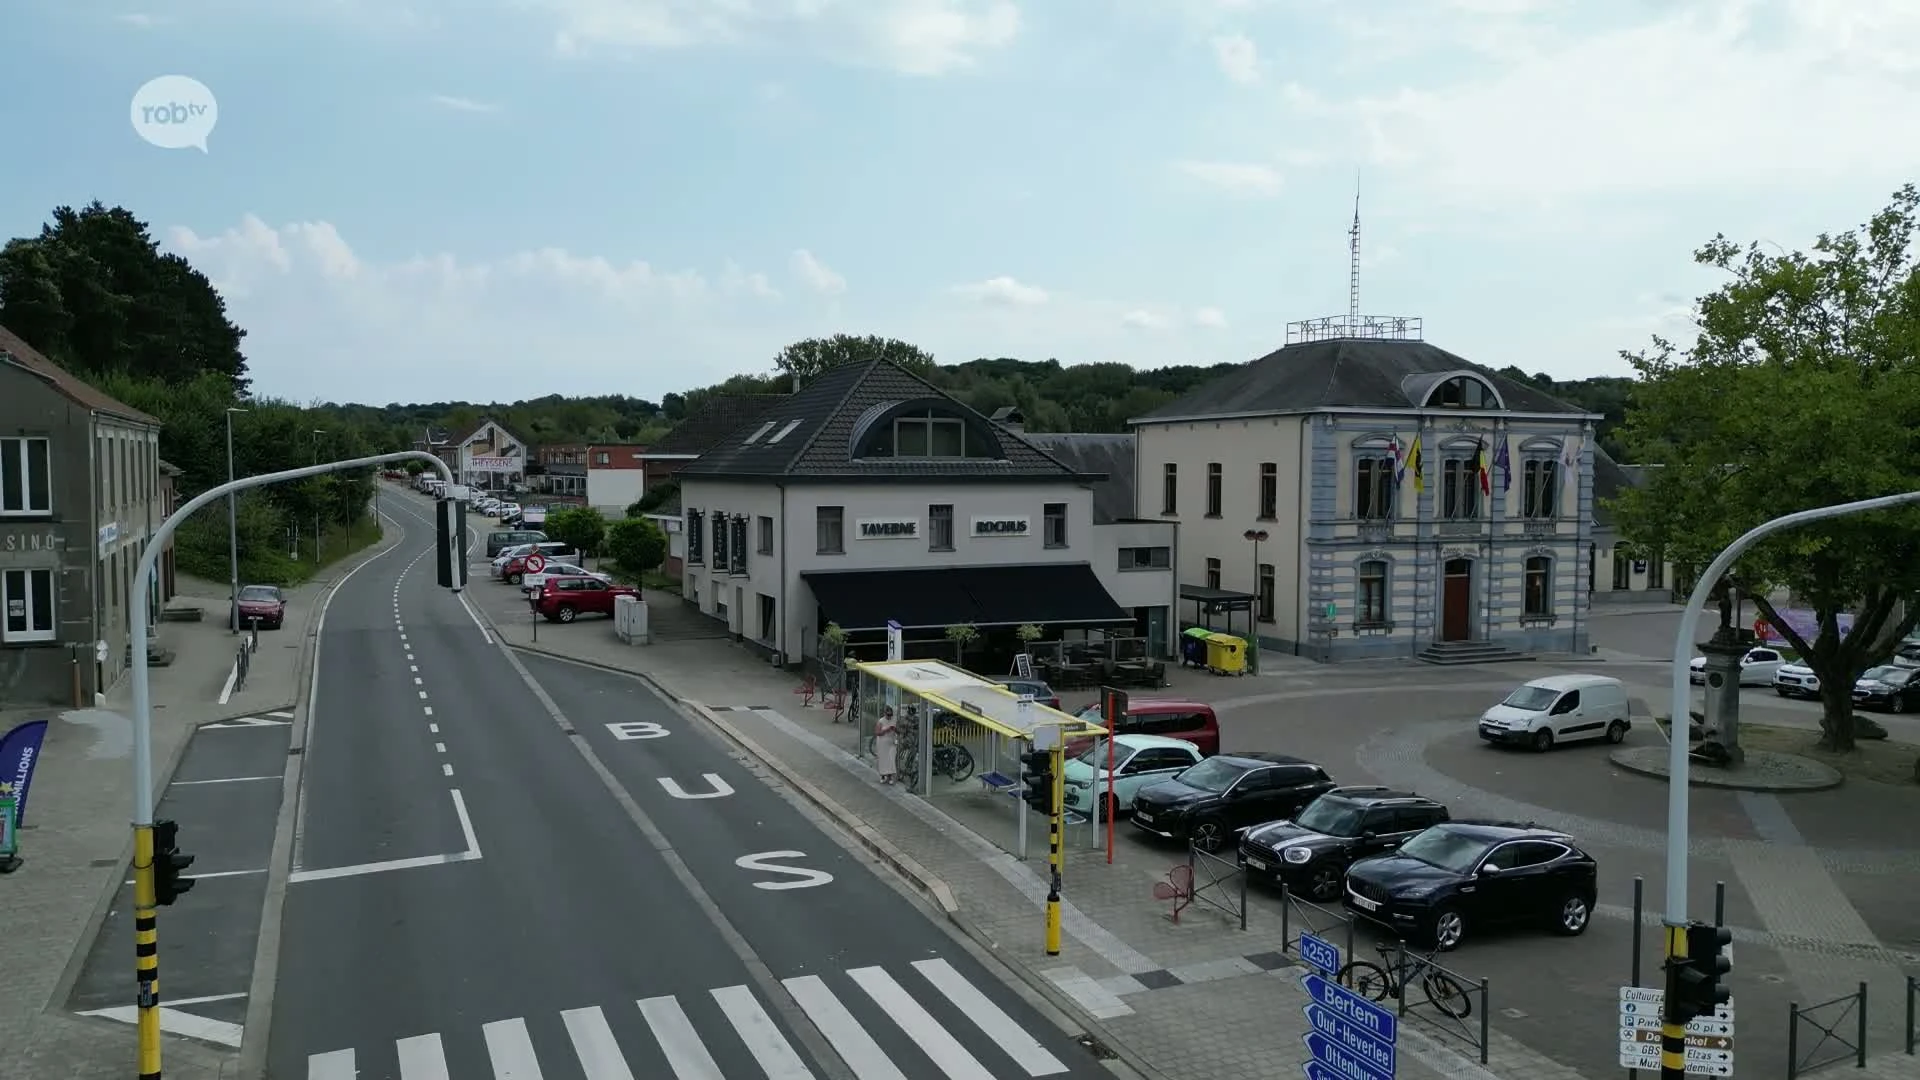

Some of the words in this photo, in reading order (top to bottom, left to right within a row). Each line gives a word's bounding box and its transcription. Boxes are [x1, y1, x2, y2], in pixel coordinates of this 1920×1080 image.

[860, 522, 916, 536] TAVERNE
[976, 520, 1027, 533] ROCHUS
[1303, 943, 1332, 968] N253
[1324, 985, 1379, 1030] Bertem
[1645, 1031, 1662, 1042] De
[1684, 1036, 1708, 1047] nkel
[1642, 1044, 1660, 1055] GBS
[1687, 1049, 1712, 1060] Elzas
[1639, 1057, 1661, 1069] Muzi
